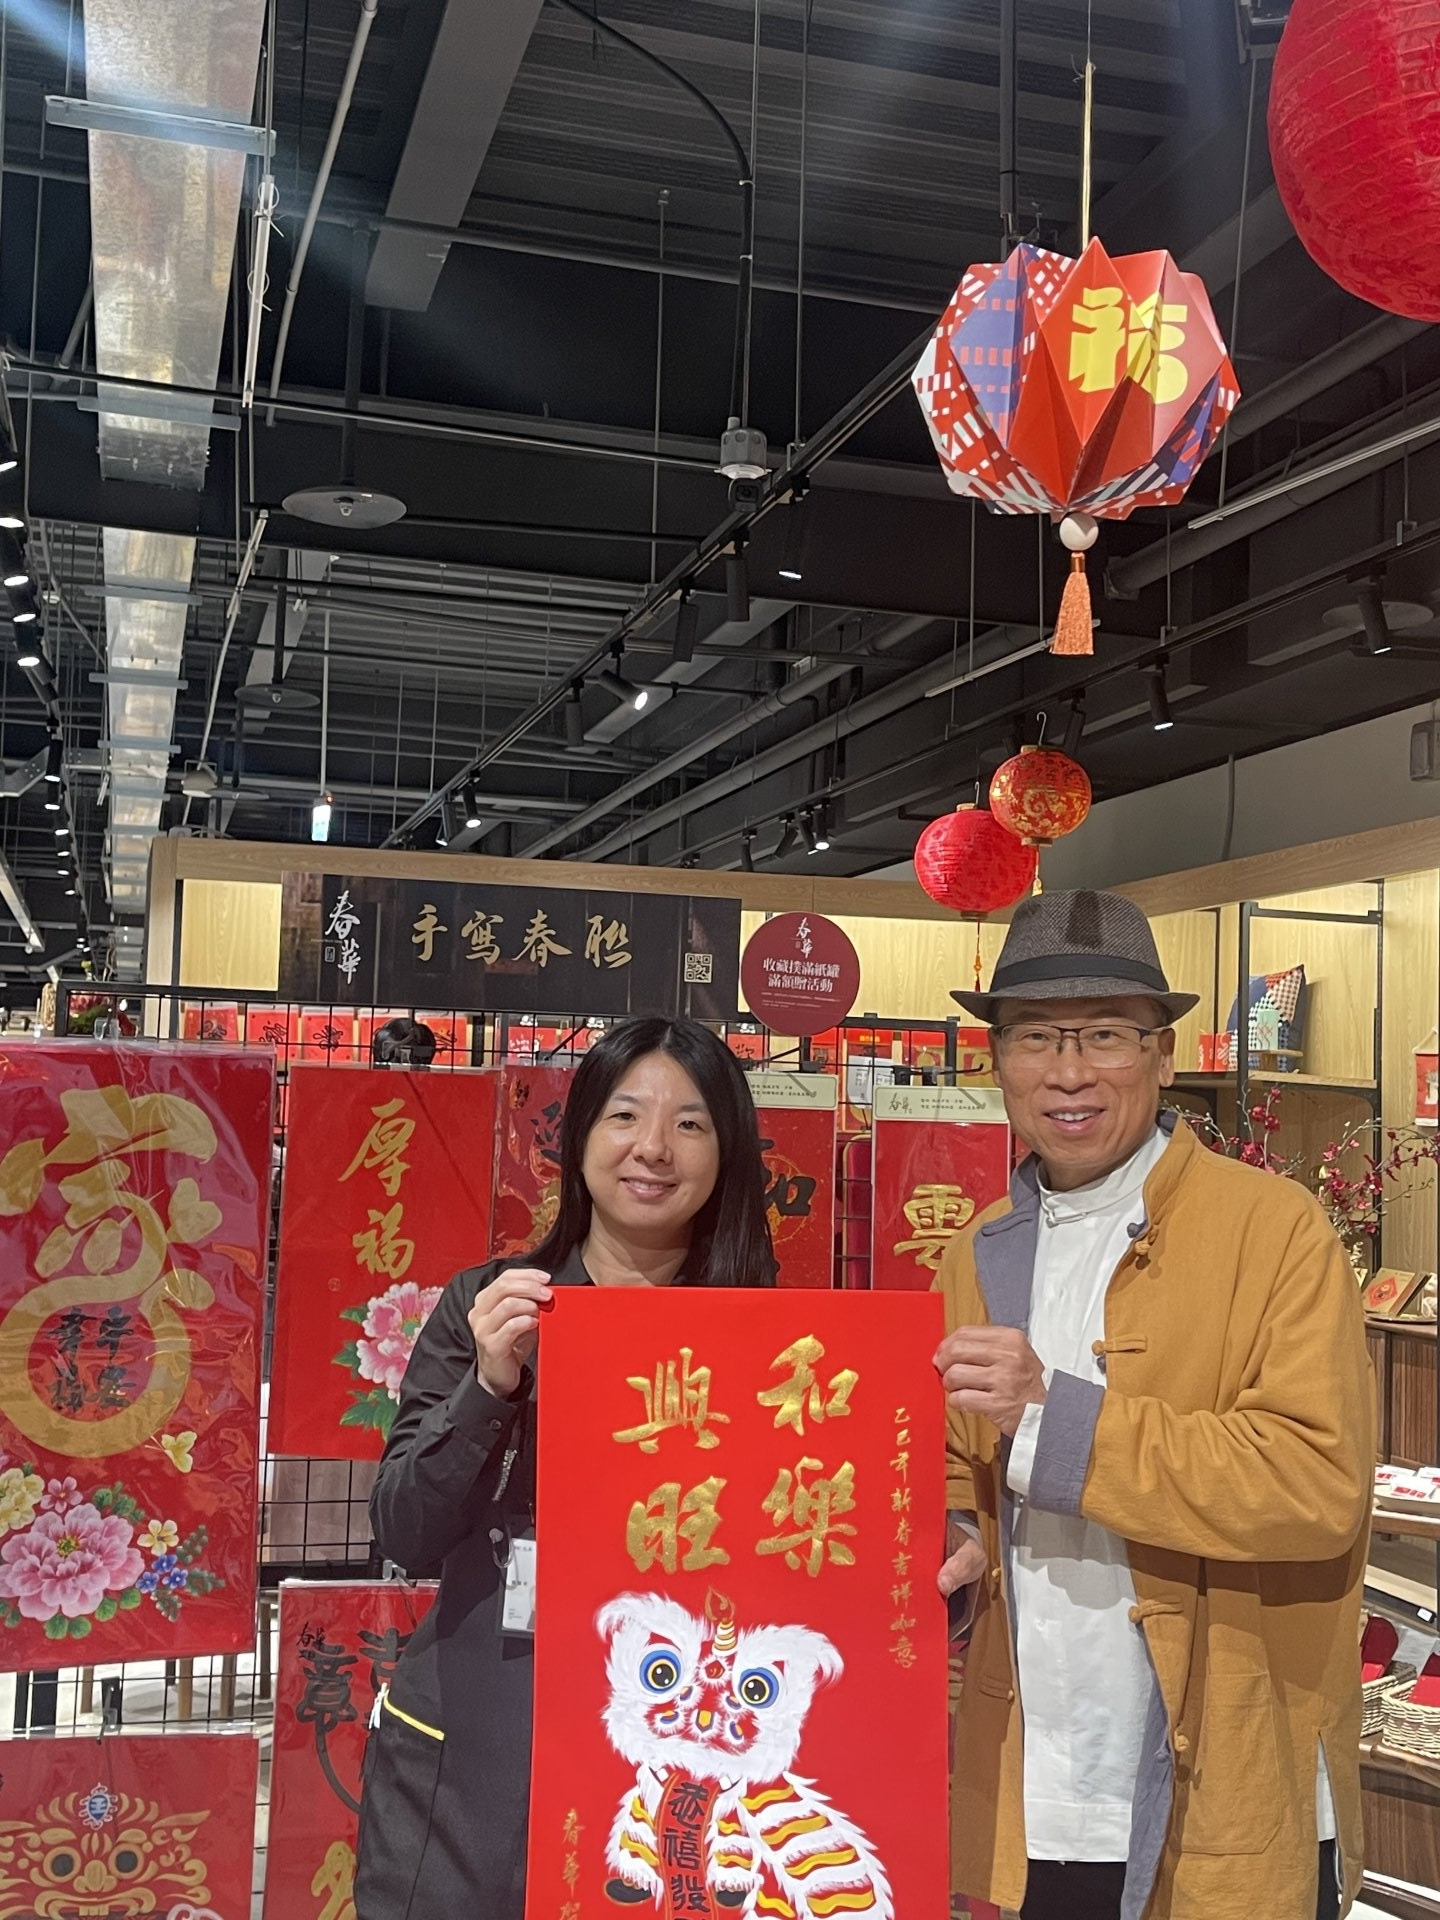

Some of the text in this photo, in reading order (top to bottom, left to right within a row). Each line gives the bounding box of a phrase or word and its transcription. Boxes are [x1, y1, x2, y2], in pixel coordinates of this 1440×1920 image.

[324, 889, 361, 985] 春華
[411, 902, 634, 970] 手寫春聯
[768, 973, 834, 993] 滿額贈活動
[336, 1097, 416, 1280] 厚福
[611, 1346, 732, 1574] 興旺
[755, 1334, 859, 1578] 和樂
[662, 1781, 712, 1920] 恭禧發
